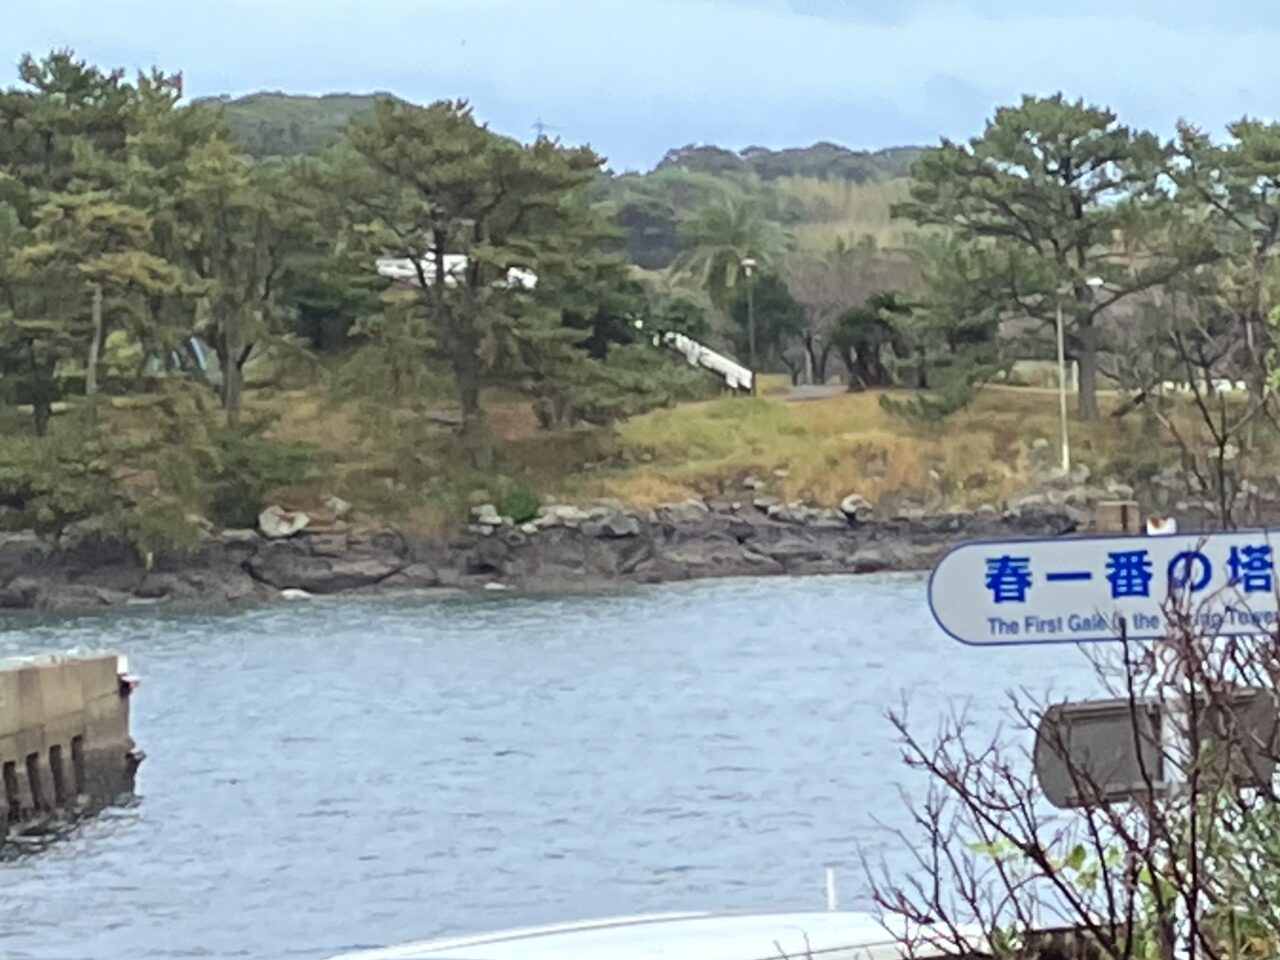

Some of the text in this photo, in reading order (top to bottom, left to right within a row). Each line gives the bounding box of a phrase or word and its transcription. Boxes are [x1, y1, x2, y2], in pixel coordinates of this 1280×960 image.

[985, 544, 1273, 604] 春一番の塔
[987, 616, 1019, 635] The
[1024, 614, 1063, 634] First
[1132, 611, 1161, 631] the
